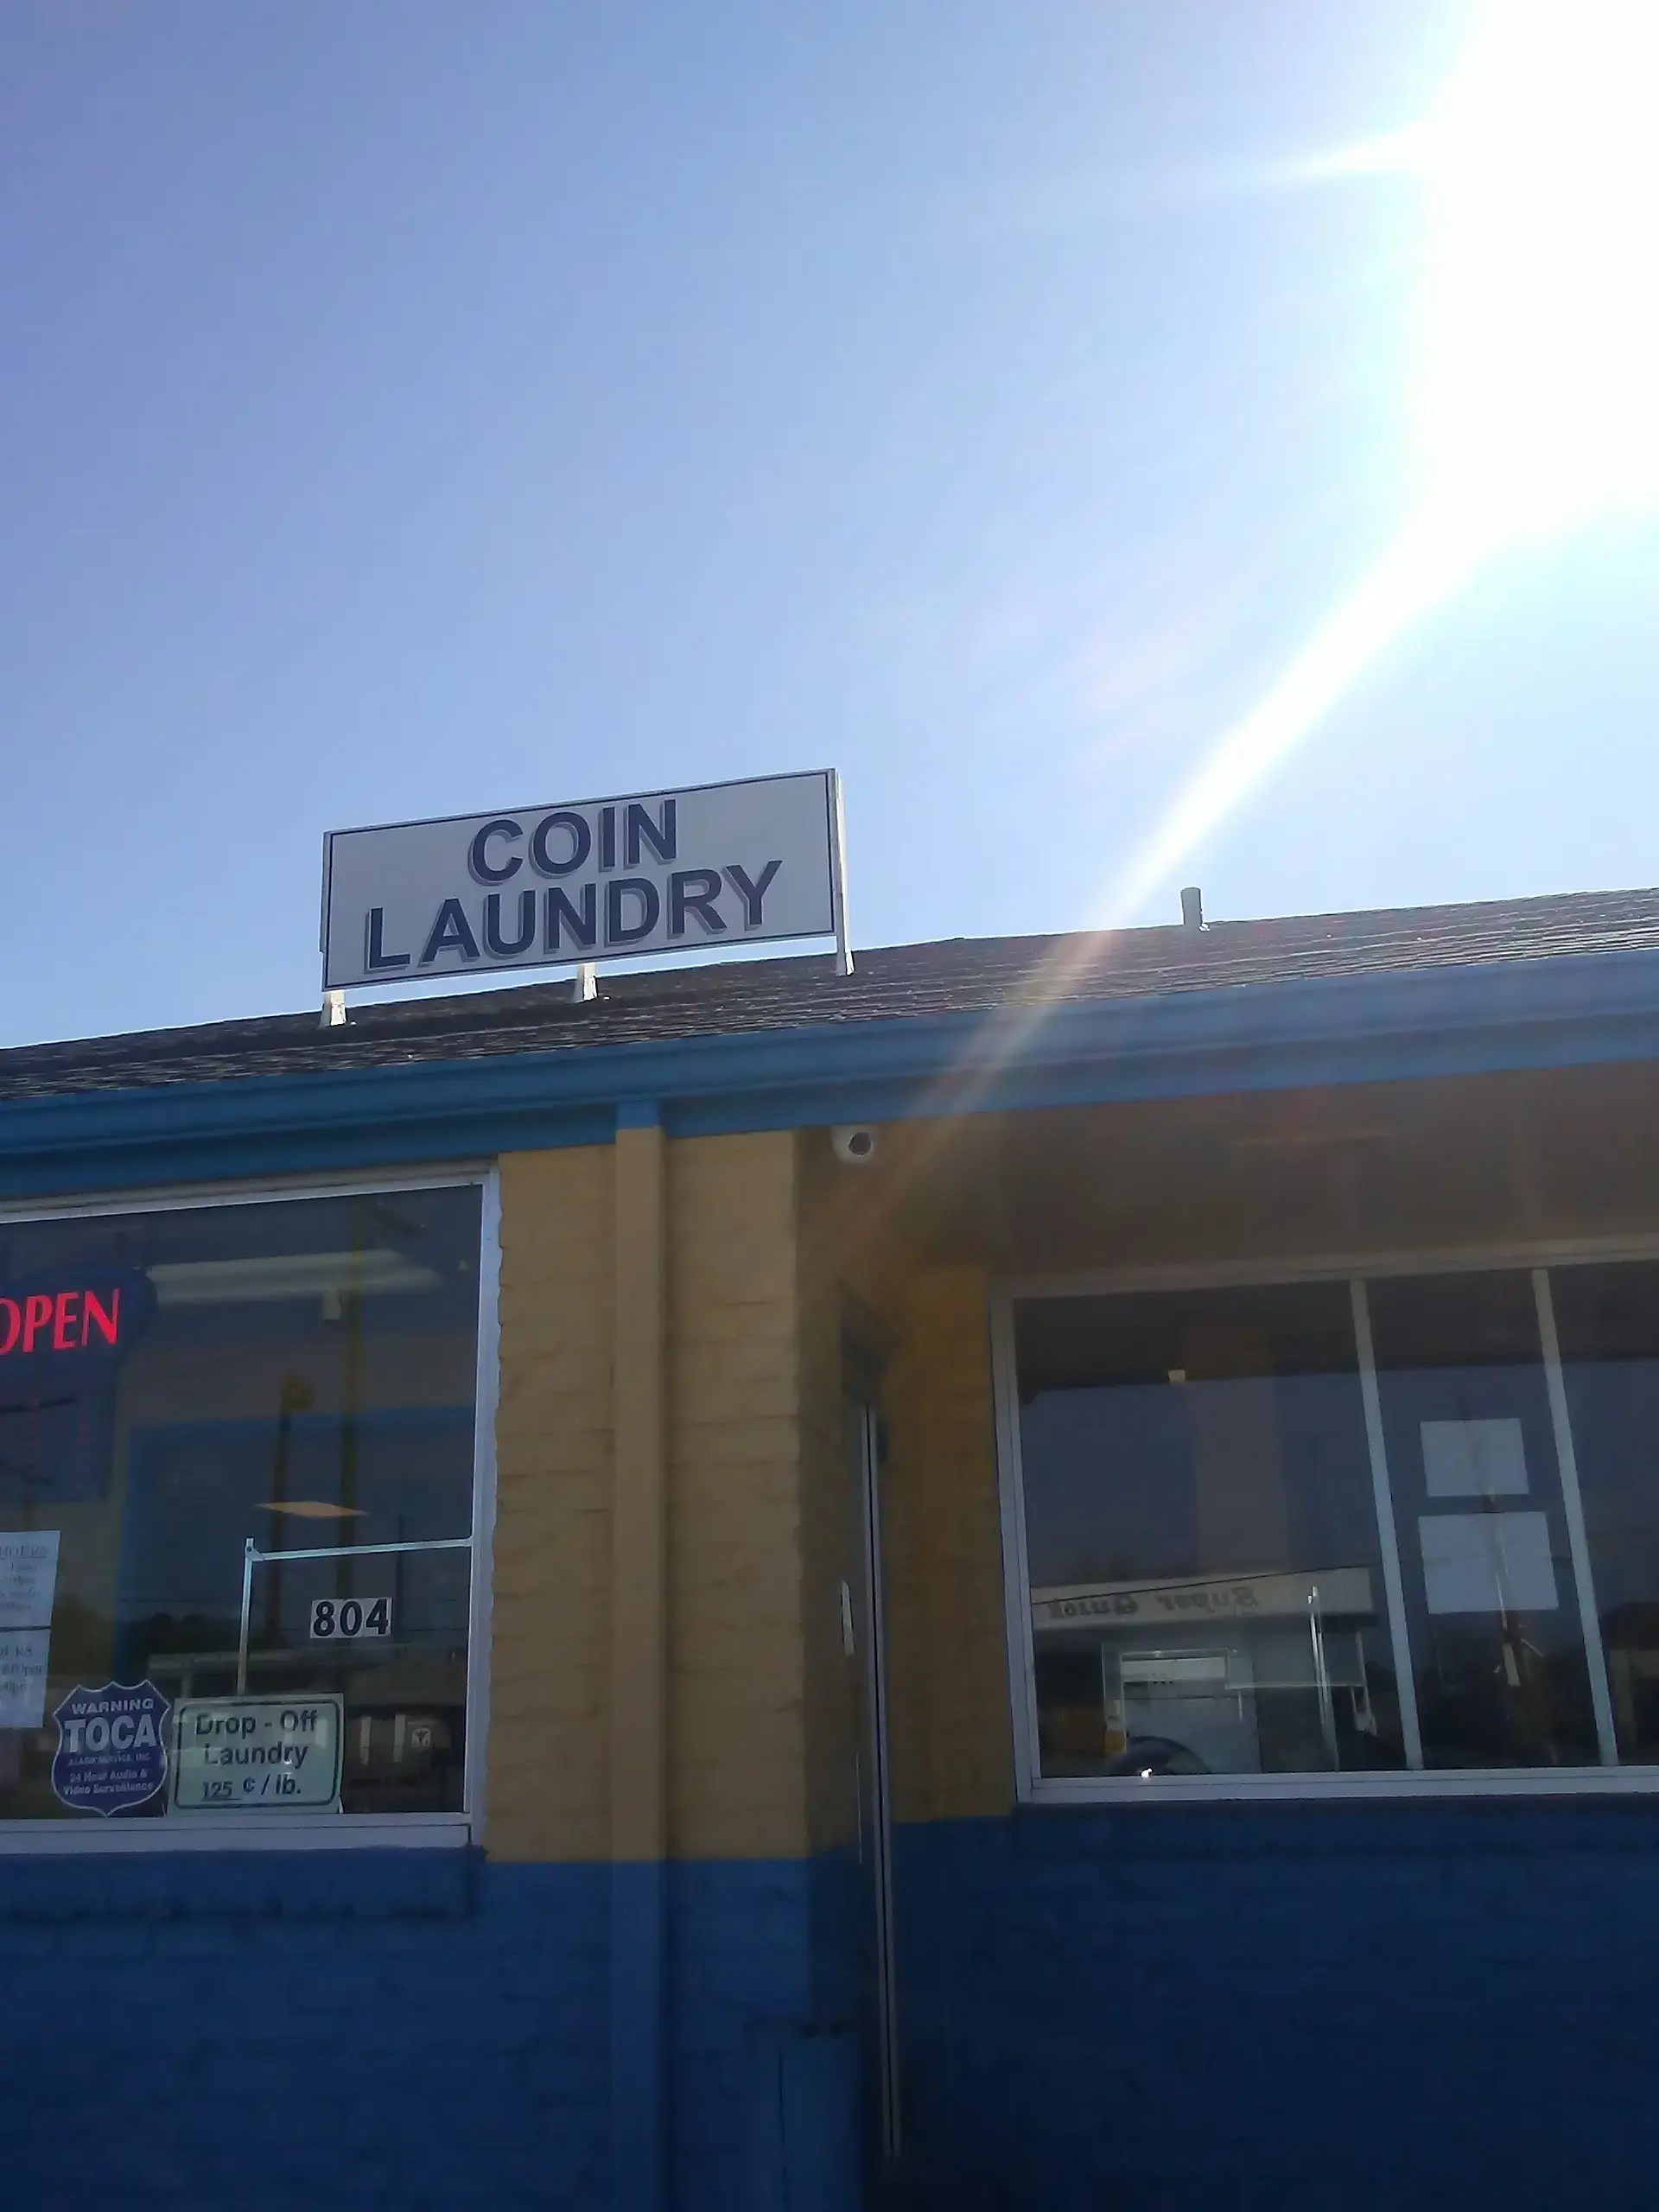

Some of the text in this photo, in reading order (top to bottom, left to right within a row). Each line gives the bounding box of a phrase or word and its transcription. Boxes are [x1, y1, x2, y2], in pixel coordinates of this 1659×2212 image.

[468, 799, 677, 886] COIN
[364, 860, 783, 974] LAUNDRY
[313, 1599, 389, 1637] 804
[72, 1698, 154, 1715] WARNING
[64, 1713, 157, 1753] TOCA
[195, 1713, 257, 1739] Drop
[280, 1710, 318, 1732] Off
[204, 1741, 309, 1770] Laundry
[110, 1769, 137, 1779] Audio
[63, 1784, 91, 1795] Video
